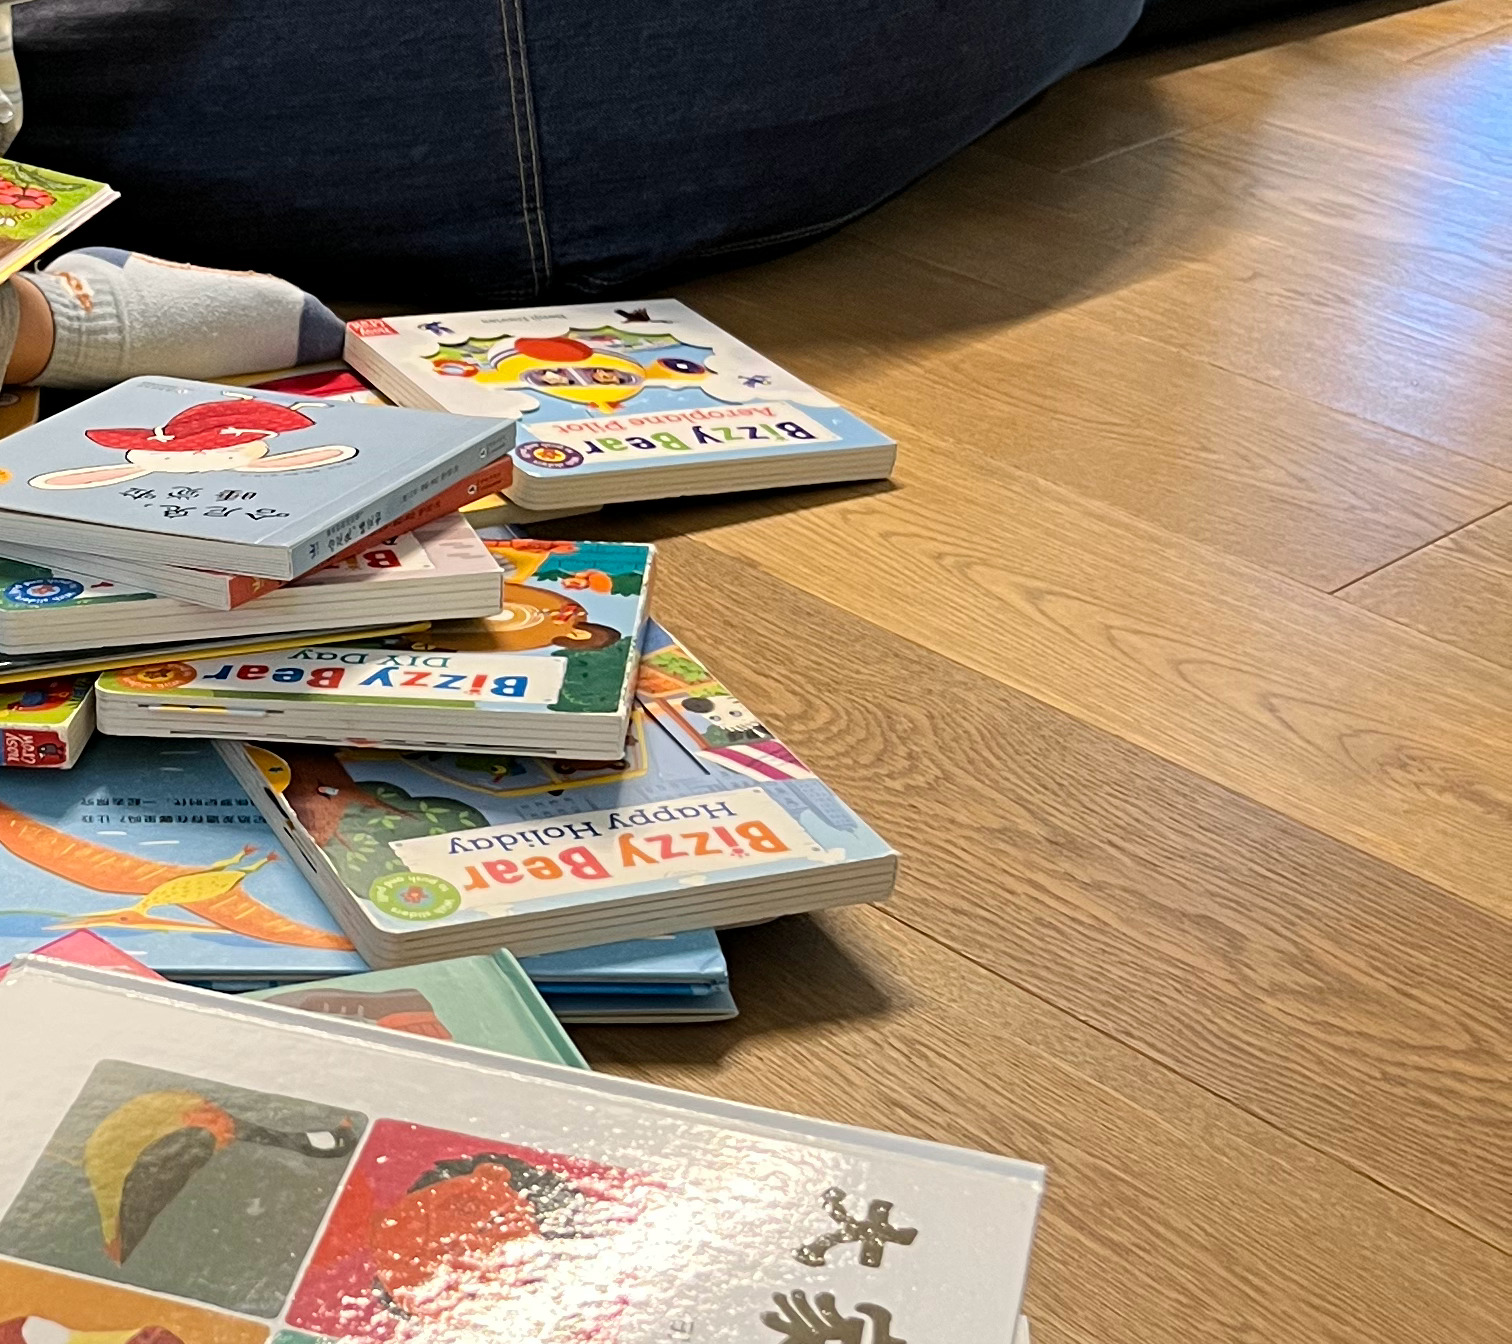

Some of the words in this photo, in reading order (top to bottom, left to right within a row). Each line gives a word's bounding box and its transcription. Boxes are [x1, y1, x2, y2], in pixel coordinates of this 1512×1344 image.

[553, 419, 620, 436] Pilot
[625, 405, 777, 432] Aeroplane
[692, 419, 816, 447] Bizzy
[585, 429, 683, 455] Bear
[287, 649, 368, 667] Day
[370, 653, 451, 669] DIY
[200, 664, 346, 690] Bear
[359, 666, 529, 698] Bizzy
[5, 732, 21, 763] nosy
[18, 733, 37, 765] crow
[607, 802, 738, 833] Happy
[448, 821, 603, 856] Holiday
[617, 821, 791, 869] Bizzy
[462, 846, 613, 892] Bear
